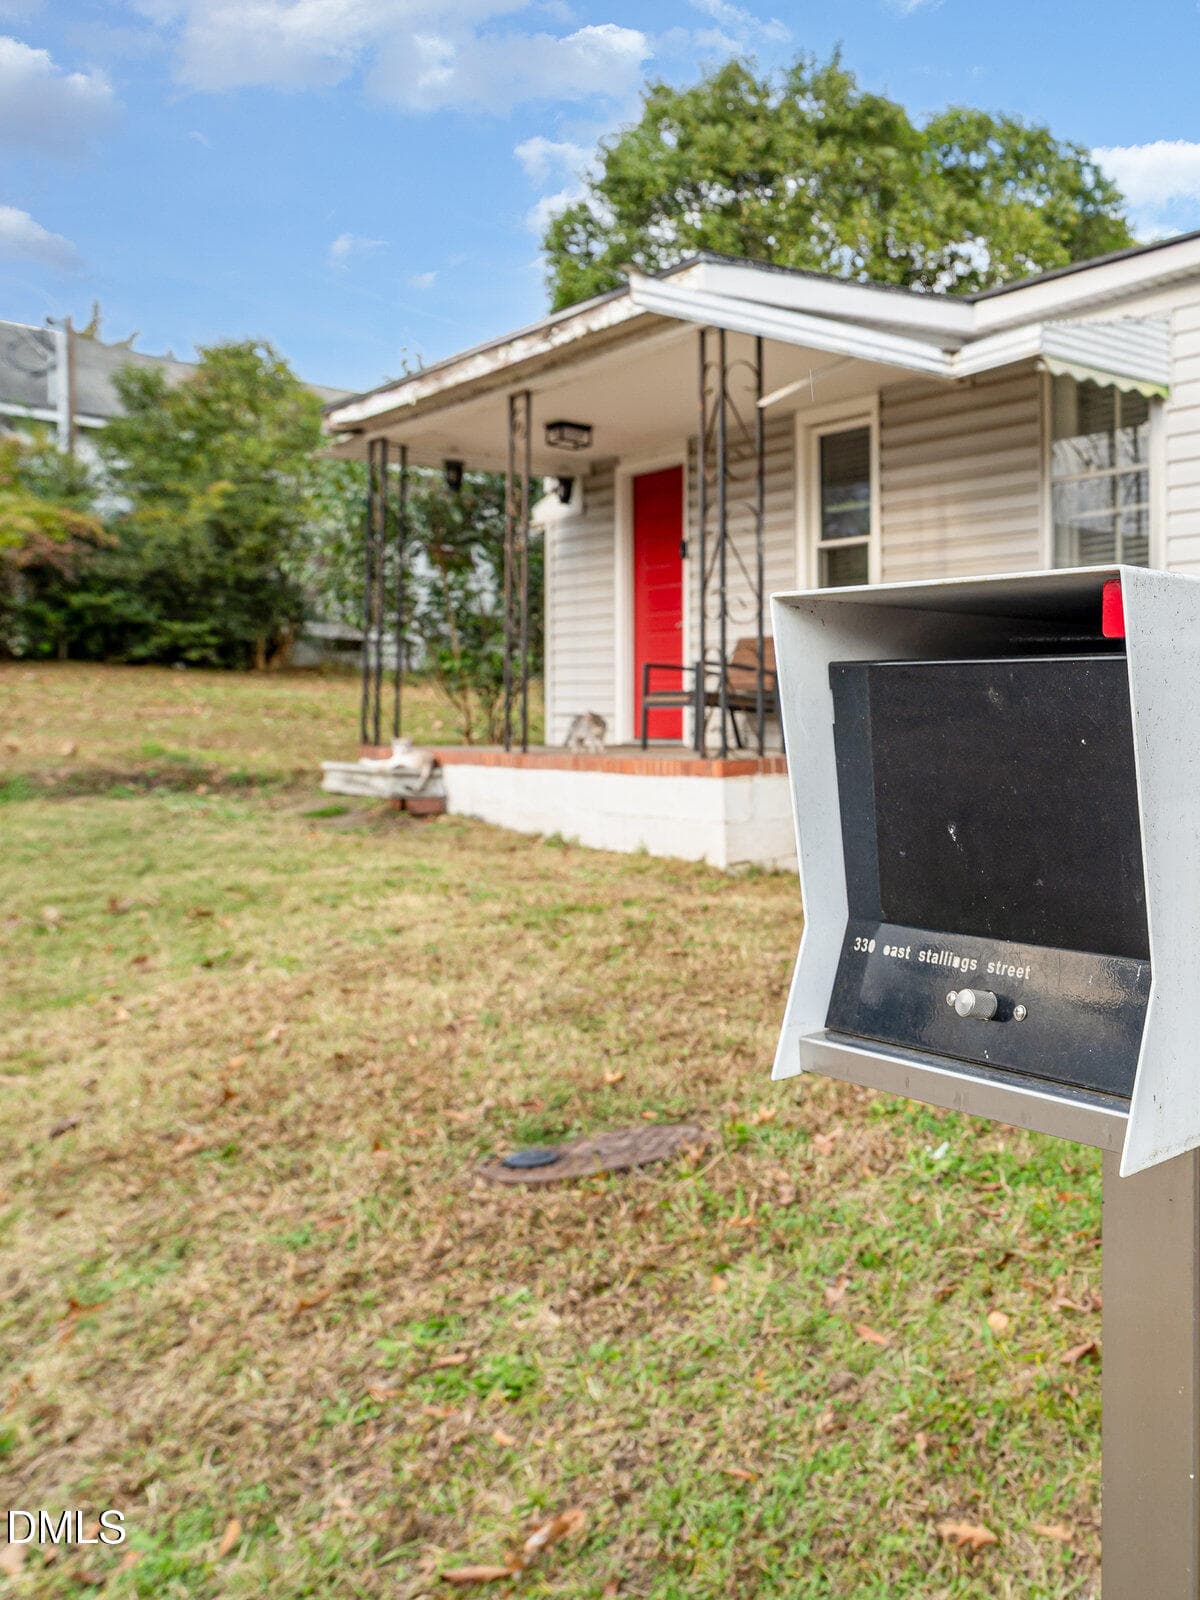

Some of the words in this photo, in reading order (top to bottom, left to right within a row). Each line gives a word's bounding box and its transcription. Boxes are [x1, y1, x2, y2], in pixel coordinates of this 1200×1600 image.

[853, 937, 876, 954] 330
[883, 944, 911, 960] east
[918, 949, 978, 973] stallings
[987, 960, 1031, 980] street
